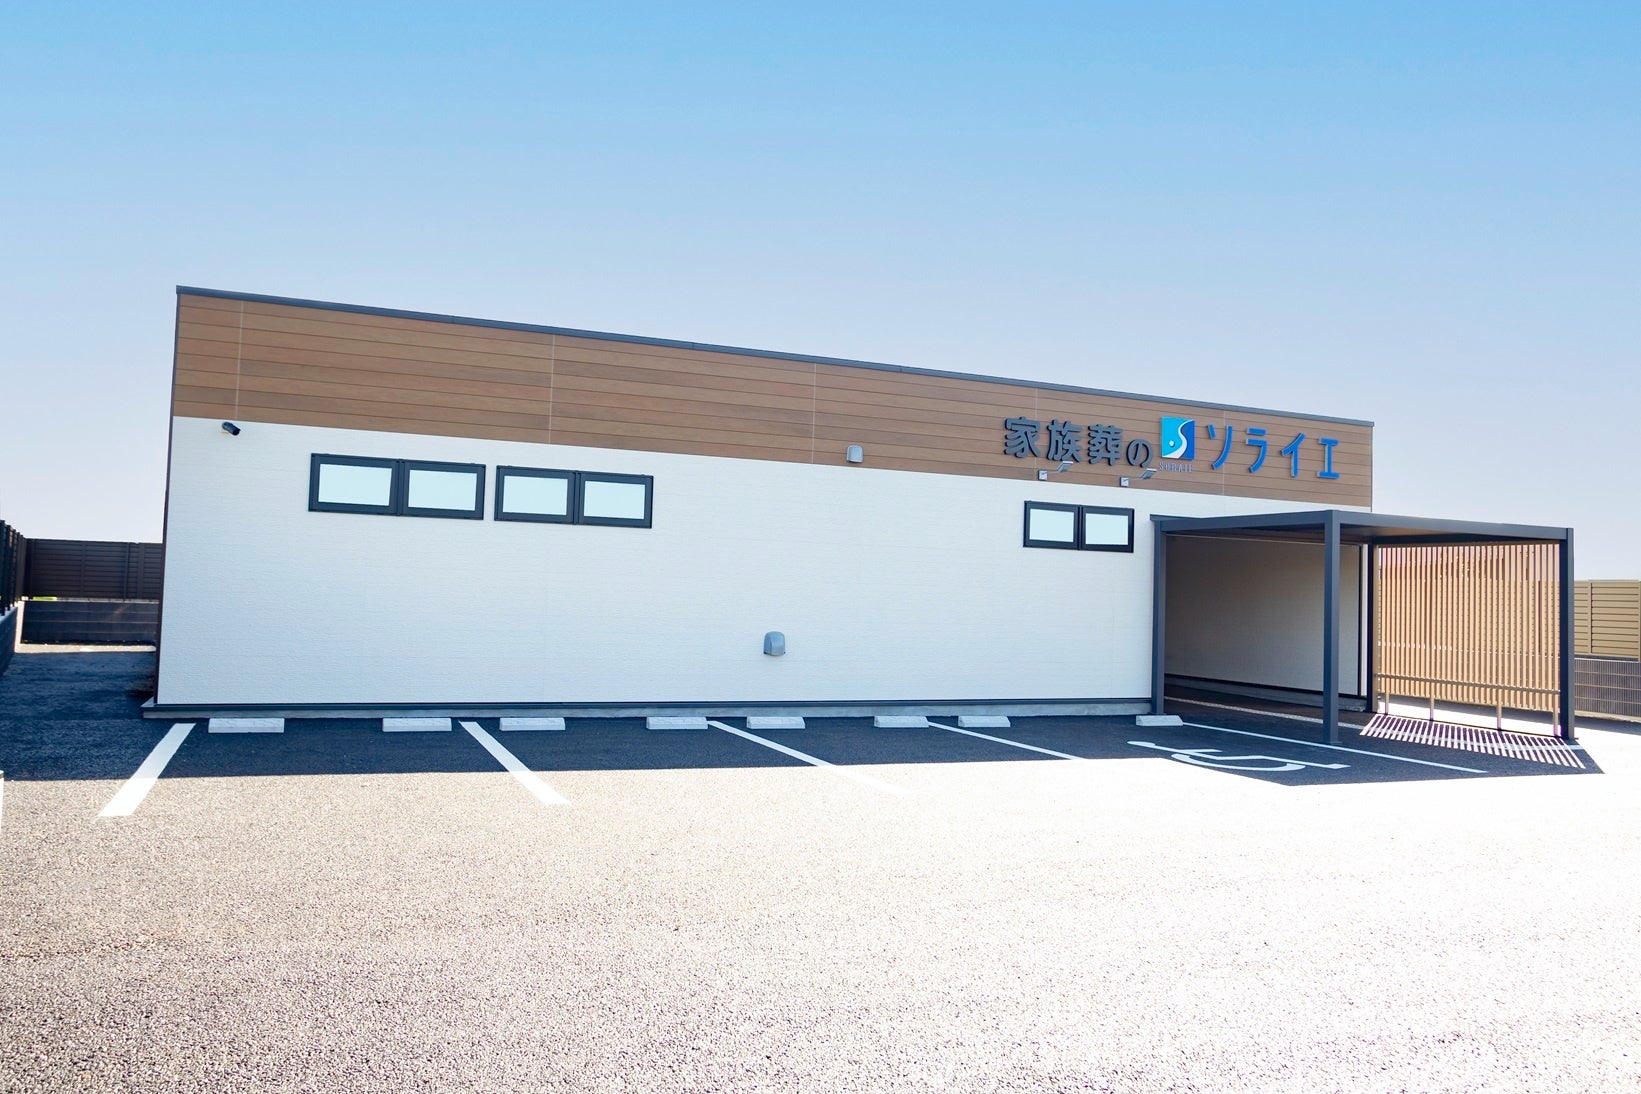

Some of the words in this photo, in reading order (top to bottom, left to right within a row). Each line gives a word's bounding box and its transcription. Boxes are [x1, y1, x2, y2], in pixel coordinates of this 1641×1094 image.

[1004, 416, 1153, 468] 家族葬の
[1207, 424, 1340, 479] ソライエ
